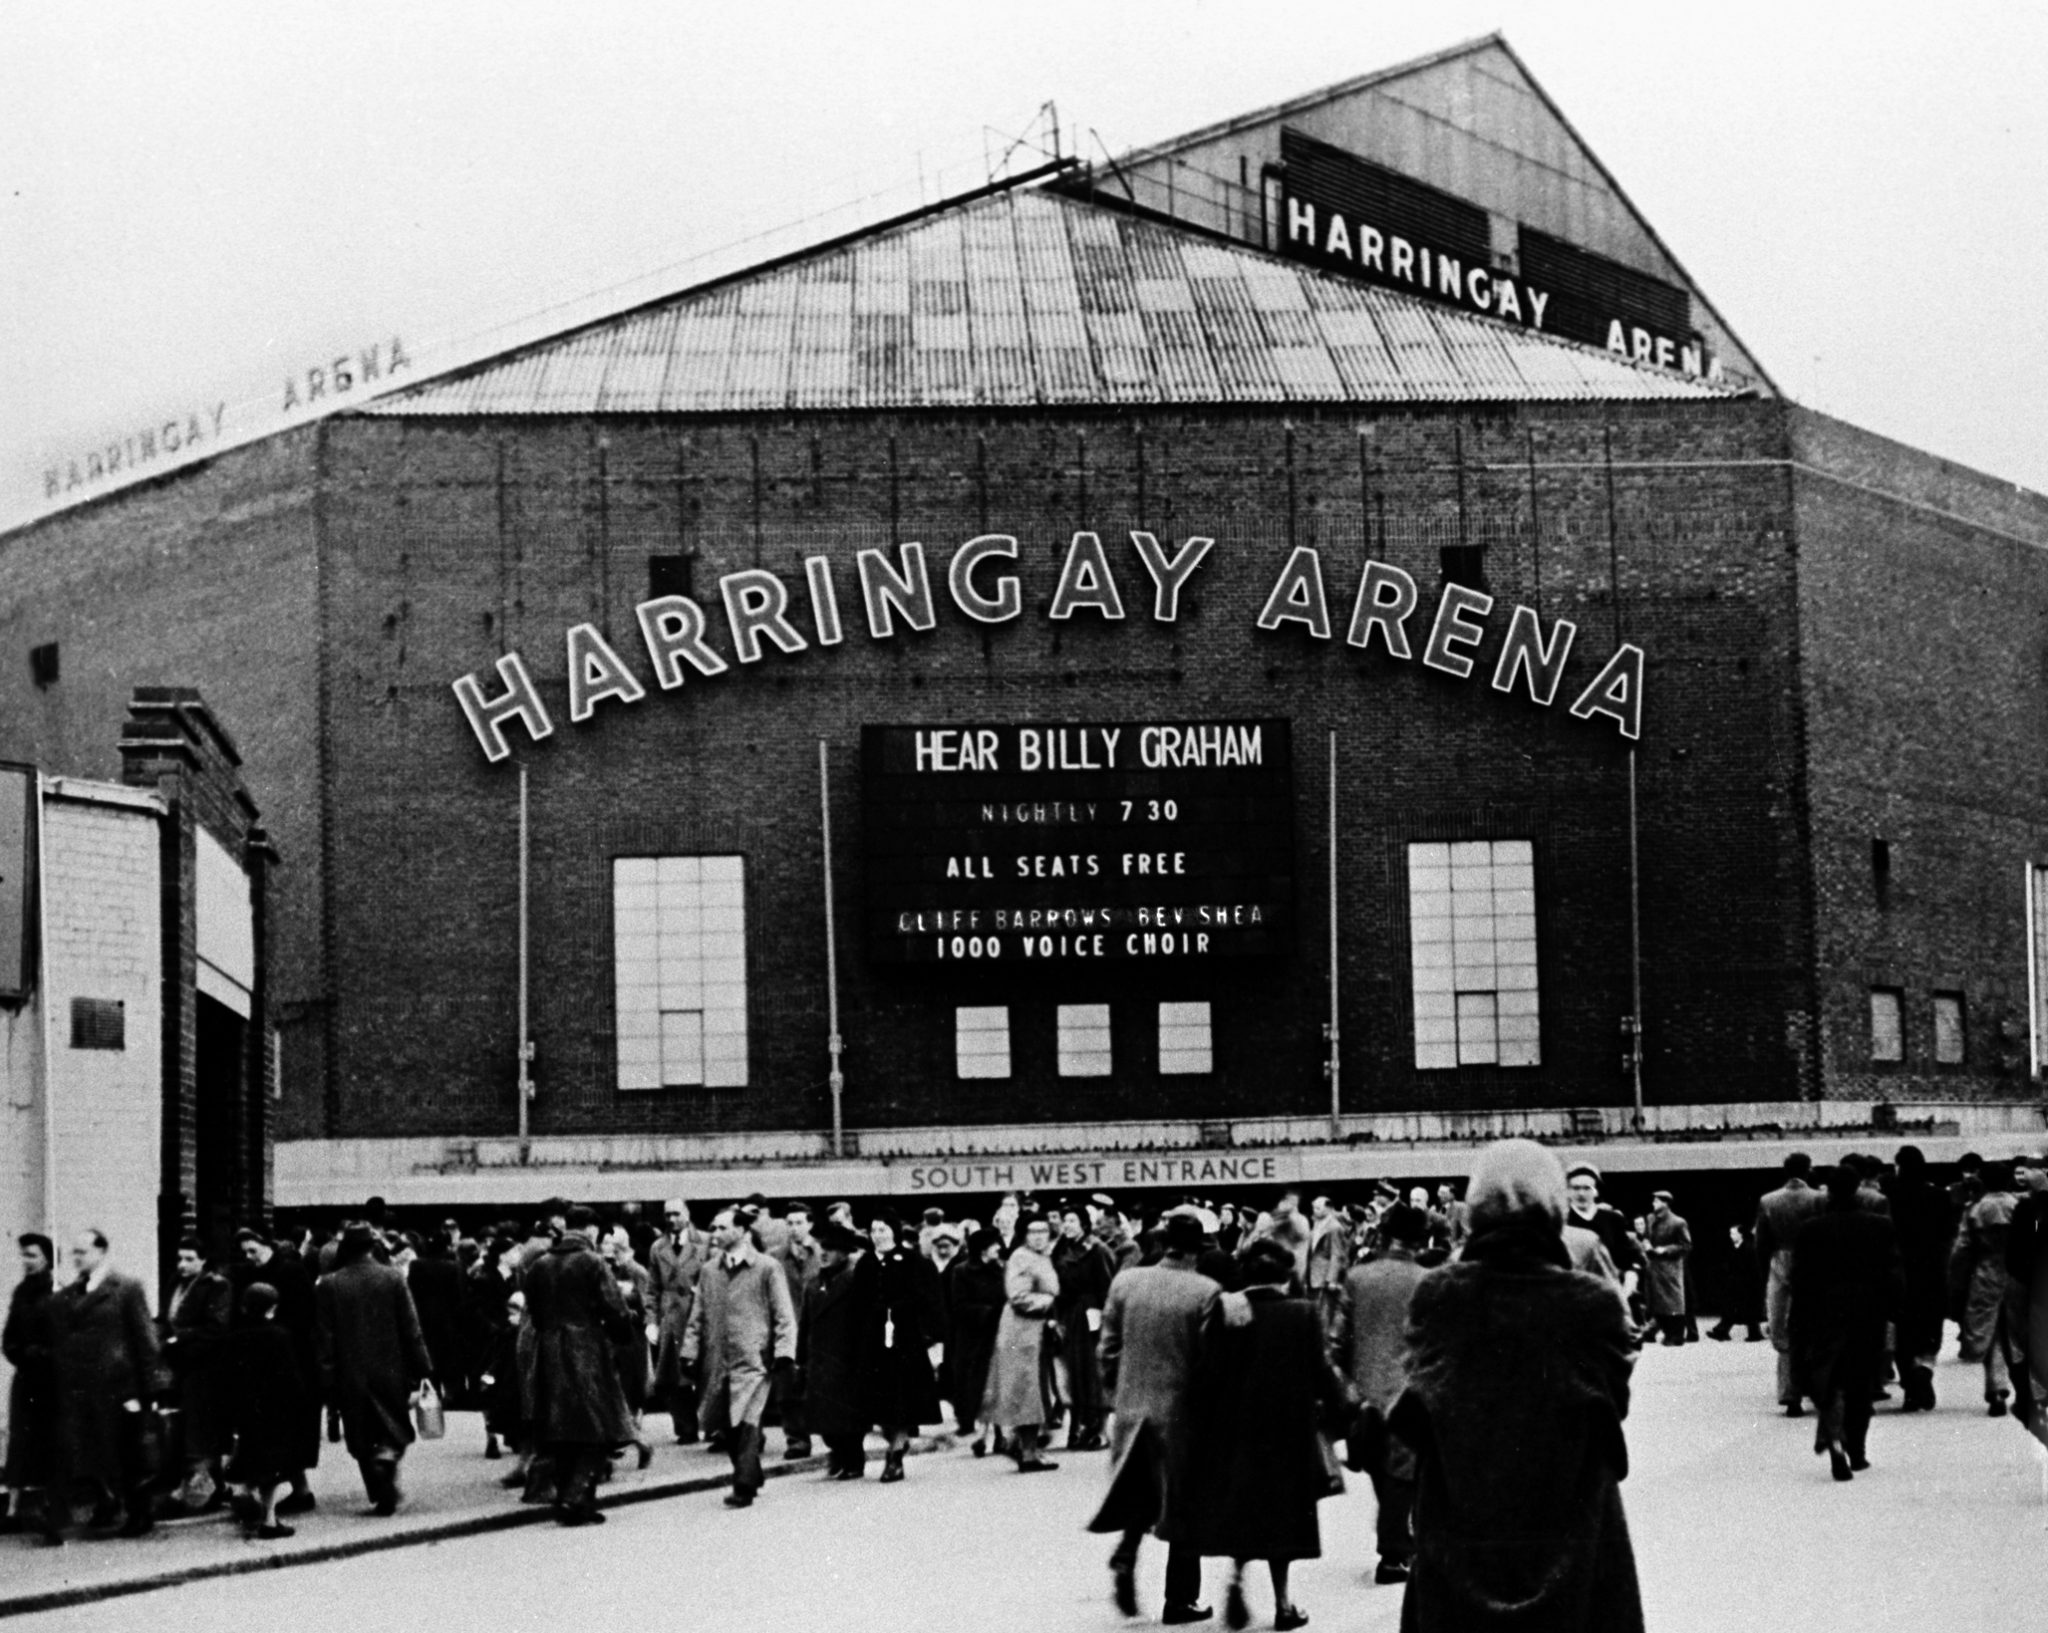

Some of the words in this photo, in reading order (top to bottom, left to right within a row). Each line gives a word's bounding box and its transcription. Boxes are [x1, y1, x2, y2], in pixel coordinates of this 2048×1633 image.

[1288, 197, 1549, 328] HARRINGAY
[43, 401, 226, 498] HARRINGAY
[452, 531, 1215, 762] HARRINGAY
[1257, 546, 1644, 740] ARENA
[915, 730, 999, 771] HEAR
[1020, 728, 1120, 771] BILLY
[1140, 726, 1262, 768] GRAHAM
[981, 802, 1098, 823] NIGHTLY
[1120, 801, 1133, 822] 7
[1147, 800, 1178, 821] 30
[946, 857, 994, 878] ALL
[1017, 855, 1100, 877] SEATS
[1122, 852, 1186, 875] FREE
[899, 911, 982, 932] CLIFF
[996, 908, 1112, 930] BARROWS
[1138, 907, 1184, 927] BEV
[1200, 905, 1263, 926] SHEA
[937, 936, 1001, 958] 1000
[1023, 935, 1105, 957] VOICE
[1126, 933, 1211, 955] CHOIR
[911, 1165, 1014, 1189] SOUTH
[1031, 1163, 1106, 1185] WEST
[1124, 1158, 1276, 1183] ENTRANCE
